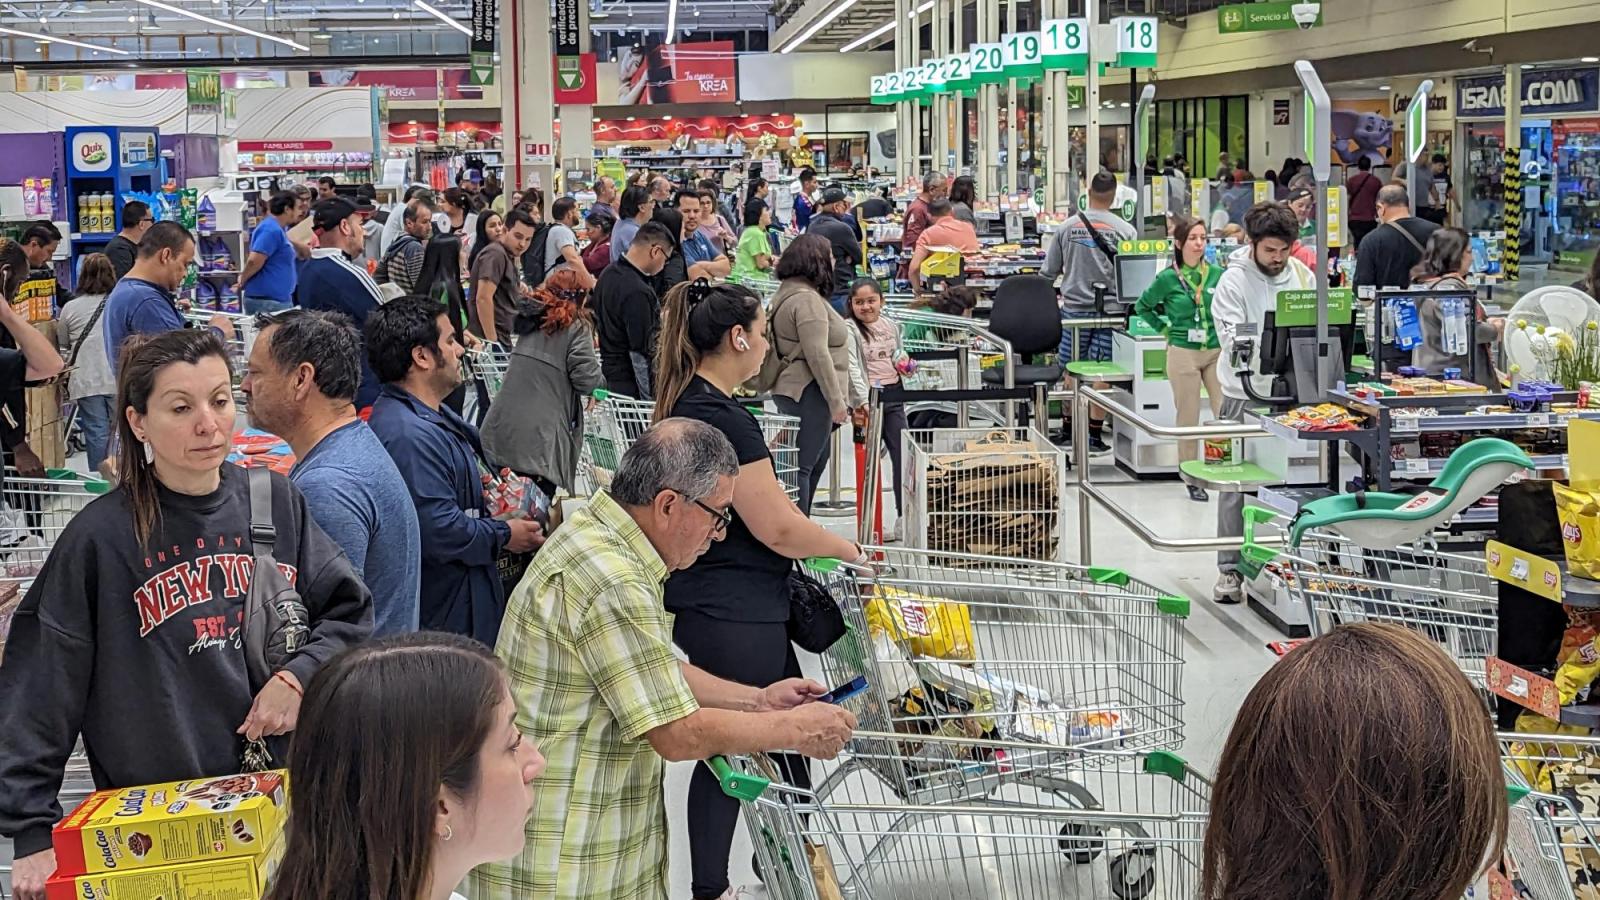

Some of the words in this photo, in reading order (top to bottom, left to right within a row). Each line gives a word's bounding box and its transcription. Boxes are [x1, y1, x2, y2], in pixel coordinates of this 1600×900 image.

[1250, 13, 1281, 23] Servicio
[1282, 12, 1289, 20] al
[484, 28, 492, 41] de
[567, 32, 576, 45] de
[1046, 22, 1081, 50] 18
[1125, 21, 1152, 48] 18
[975, 48, 1002, 70] 20
[1008, 36, 1038, 60] 19
[389, 87, 416, 97] KREA
[700, 79, 728, 92] KREA
[1462, 78, 1579, 110] ISRAE.COM
[81, 142, 103, 158] Quix
[1285, 292, 1300, 301] Caja
[1302, 291, 1345, 300] autovicio
[144, 545, 180, 568] ONE
[196, 535, 242, 549] DAY
[133, 555, 213, 637] NEW
[214, 553, 298, 598] YO
[114, 789, 147, 817] ColaCao
[95, 829, 117, 868] ColaCao
